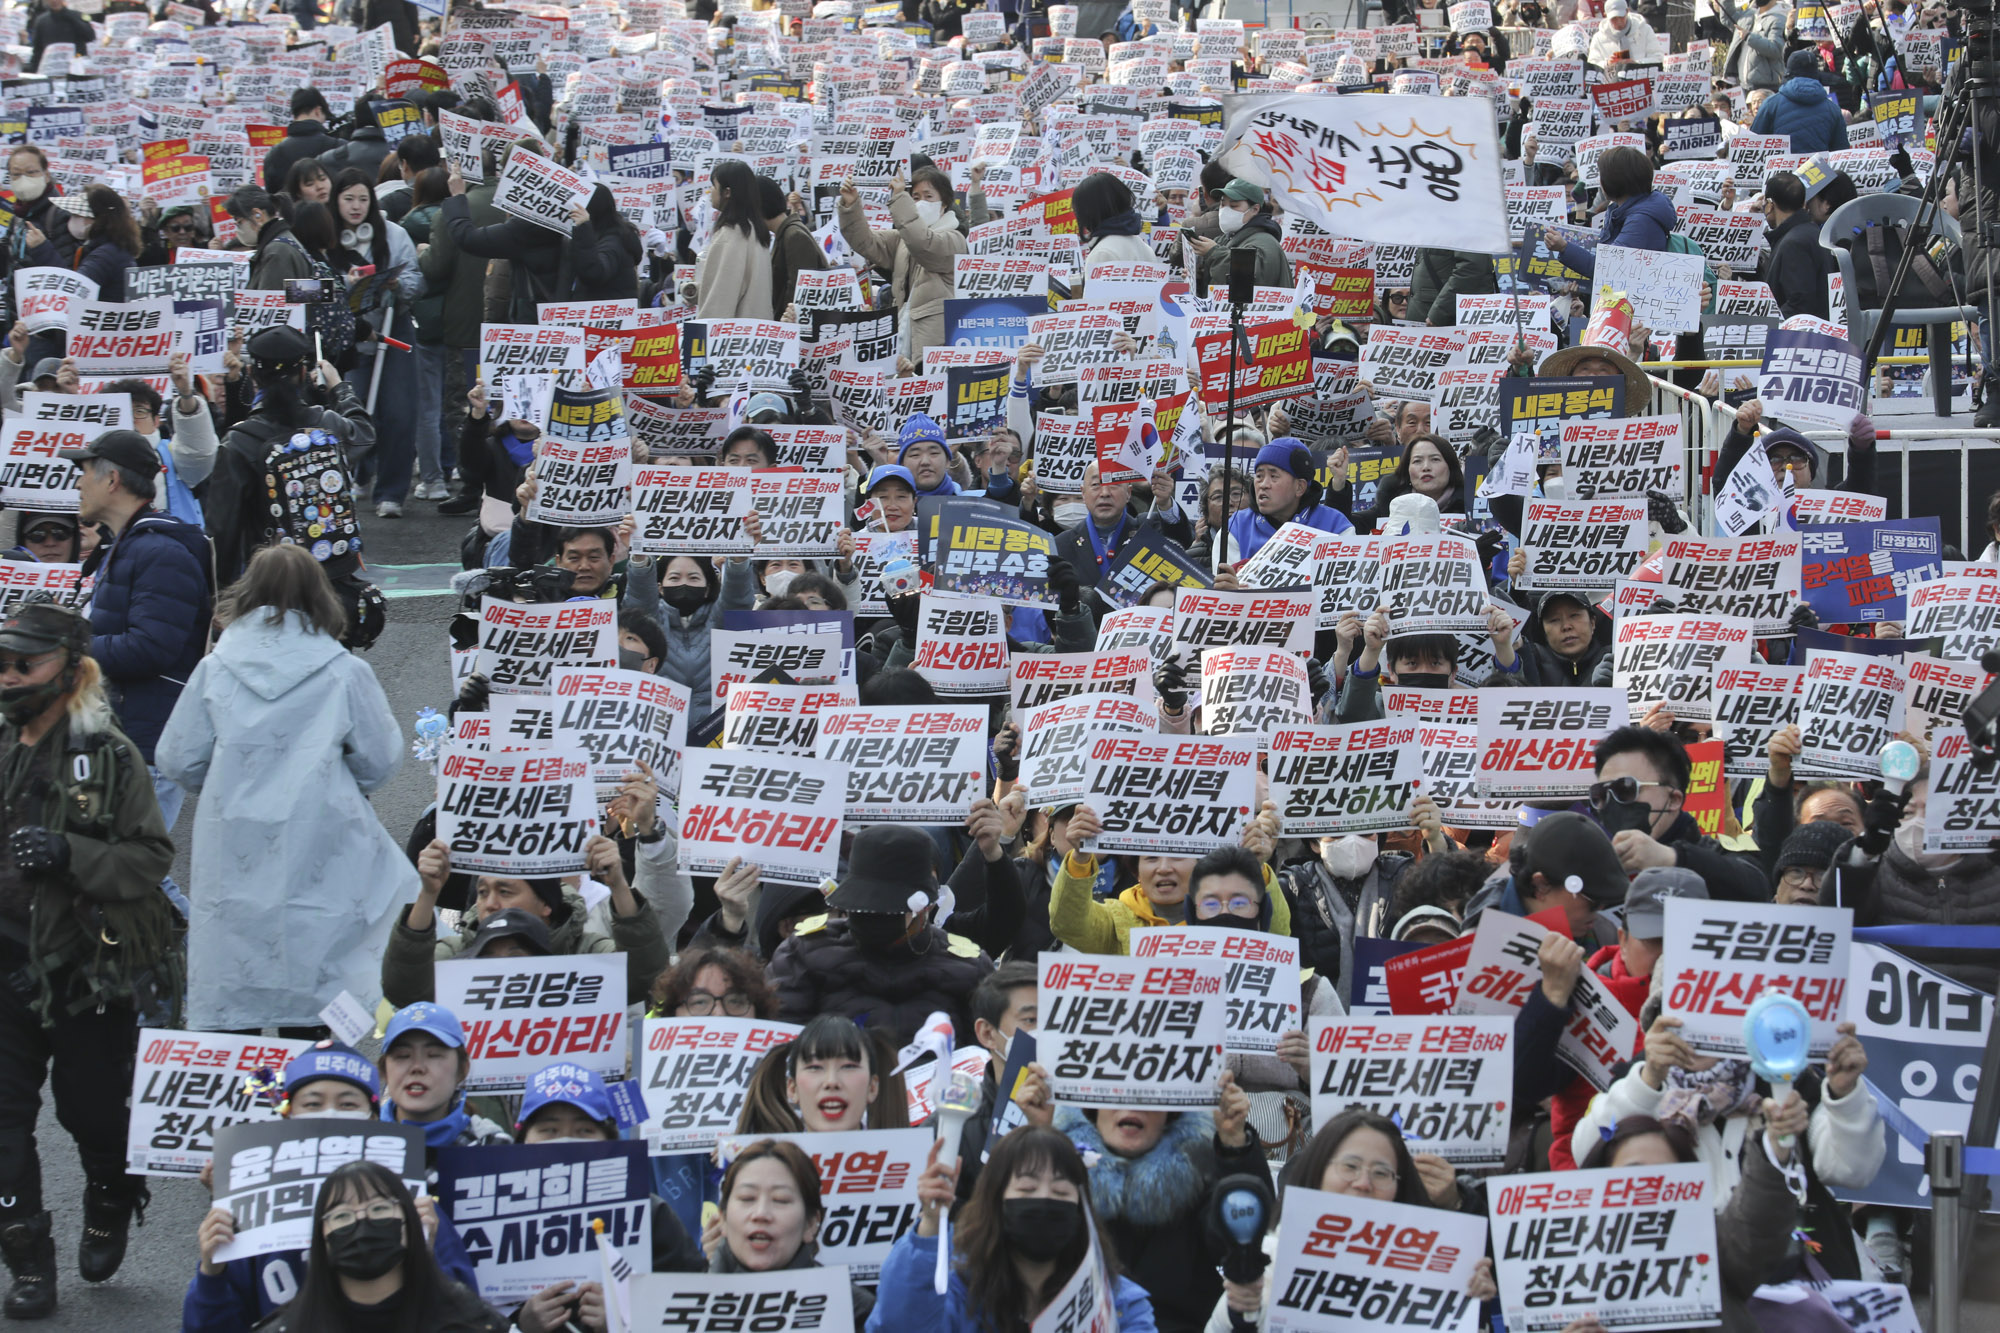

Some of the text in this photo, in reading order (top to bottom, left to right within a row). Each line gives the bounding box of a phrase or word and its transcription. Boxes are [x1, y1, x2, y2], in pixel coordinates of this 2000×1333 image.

[1526, 72, 1572, 83] 내란세력
[1530, 84, 1577, 97] 청산하자
[1657, 82, 1702, 94] 내란세력
[1535, 112, 1583, 124] 내란세력
[1537, 124, 1587, 138] 청산하자
[1668, 134, 1720, 150] 수사하라!
[511, 150, 551, 176] 애국으로
[506, 166, 576, 205] 내란세력
[504, 186, 574, 224] 청산하자
[1688, 213, 1727, 226] 애국으로
[1689, 226, 1752, 245] 내란세력
[958, 259, 1046, 273] 애국으로 단결하여
[958, 274, 1033, 292] 내란세력
[1332, 276, 1371, 293] 파면!
[80, 308, 161, 332] 국힘당을
[1331, 299, 1369, 316] 해산!
[484, 328, 582, 345] 애국으로 단결하여
[709, 323, 799, 340] 애국으로 단결하여
[1031, 316, 1075, 334] 애국으로
[1371, 329, 1418, 346] 애국으로
[69, 331, 173, 358] 해산하라!
[484, 345, 569, 366] 내란세력
[631, 334, 675, 357] 파면!
[710, 338, 784, 358] 내란세력
[1035, 330, 1113, 353] 내란세력
[1256, 330, 1303, 359] 파면!
[716, 358, 791, 379] 청산하자
[1369, 346, 1452, 369] 내란세력
[1767, 347, 1864, 382] 김건희를
[632, 363, 677, 384] 해산!
[1259, 359, 1307, 388] 해산!
[1512, 387, 1615, 419] 내란종식
[1761, 377, 1863, 411] 수사하라!
[1563, 423, 1679, 442] 애국으로 단결하여
[581, 446, 629, 463] 단결하여
[1566, 441, 1664, 467] 내란세력
[537, 461, 618, 488] 내란세력
[635, 470, 748, 489] 애국으로 단결하여
[1576, 466, 1672, 494] 청산하자
[540, 487, 626, 512] 청산하자
[635, 489, 733, 514] 내란세력
[1527, 504, 1644, 523] 애국으로 단결하여
[643, 515, 741, 541] 청산하자
[950, 525, 1050, 555] 내란종식
[1525, 524, 1630, 549] 내란세력
[1881, 534, 1930, 549] 만장일치
[945, 550, 1049, 578] 민주수호
[1532, 550, 1637, 575] 청산하자
[1666, 540, 1798, 563] 애국으로 단결하여
[1382, 561, 1472, 592] 내란세력
[1667, 562, 1781, 593] 내란세력
[1801, 551, 1895, 590] 윤석열을
[484, 605, 613, 630] 애국으로 단결하여
[1178, 594, 1313, 620] 애국으로 단결하여
[1388, 591, 1485, 620] 청산하자
[926, 608, 998, 637] 국힘당을
[1175, 617, 1295, 648] 내란세력
[1618, 620, 1748, 643] 애국으로 단결하여
[482, 628, 600, 659] 내란세력
[918, 640, 1006, 671] 해산하라!
[1618, 643, 1727, 672] 내란세력
[1808, 657, 1858, 682] 애국으로
[557, 674, 686, 714] 애국으로 단결하여
[1205, 674, 1301, 707] 내란세력
[1803, 682, 1895, 725] 내란세력
[557, 699, 674, 741] 내란세력
[823, 712, 984, 735] 애국으로 단결하여
[1500, 700, 1612, 731] 국힘당을
[824, 737, 960, 769] 내란세력
[1091, 737, 1252, 767] 애국으로 단결하여
[1271, 726, 1416, 752] 애국으로 단결하여
[443, 754, 587, 783] 애국으로 단결하여
[1272, 750, 1399, 785] 내란세력
[700, 763, 825, 805] 국힘당을
[1089, 766, 1230, 802] 내란세력
[441, 782, 574, 818] 내란세력
[1283, 784, 1413, 818] 청산하자
[680, 804, 839, 853] 해산하라!
[1102, 801, 1240, 837] 청산하자
[449, 818, 589, 856] 청산하자
[1220, 936, 1295, 965] 단결하여
[1691, 919, 1835, 964] 국힘당을
[464, 971, 604, 1010] 국힘당을
[1043, 963, 1223, 995] 애국으로 단결하여
[1043, 996, 1204, 1038] 내란세력
[1317, 1025, 1508, 1053] 애국으로 단결하여
[315, 1054, 372, 1083] 민주여성
[1054, 1040, 1215, 1083] 청산하자
[1318, 1057, 1484, 1097] 내란세력
[229, 1135, 406, 1191] 윤석열을
[453, 1156, 628, 1221] 김건희를
[1496, 1175, 1704, 1215] 애국으로 단결하여
[1302, 1213, 1460, 1274] 윤석열을
[1503, 1209, 1677, 1261] 내란세력
[1524, 1255, 1694, 1308] 청산하자
[662, 1292, 828, 1333] 국힘당을
[1277, 1267, 1471, 1331] 파면하라!
